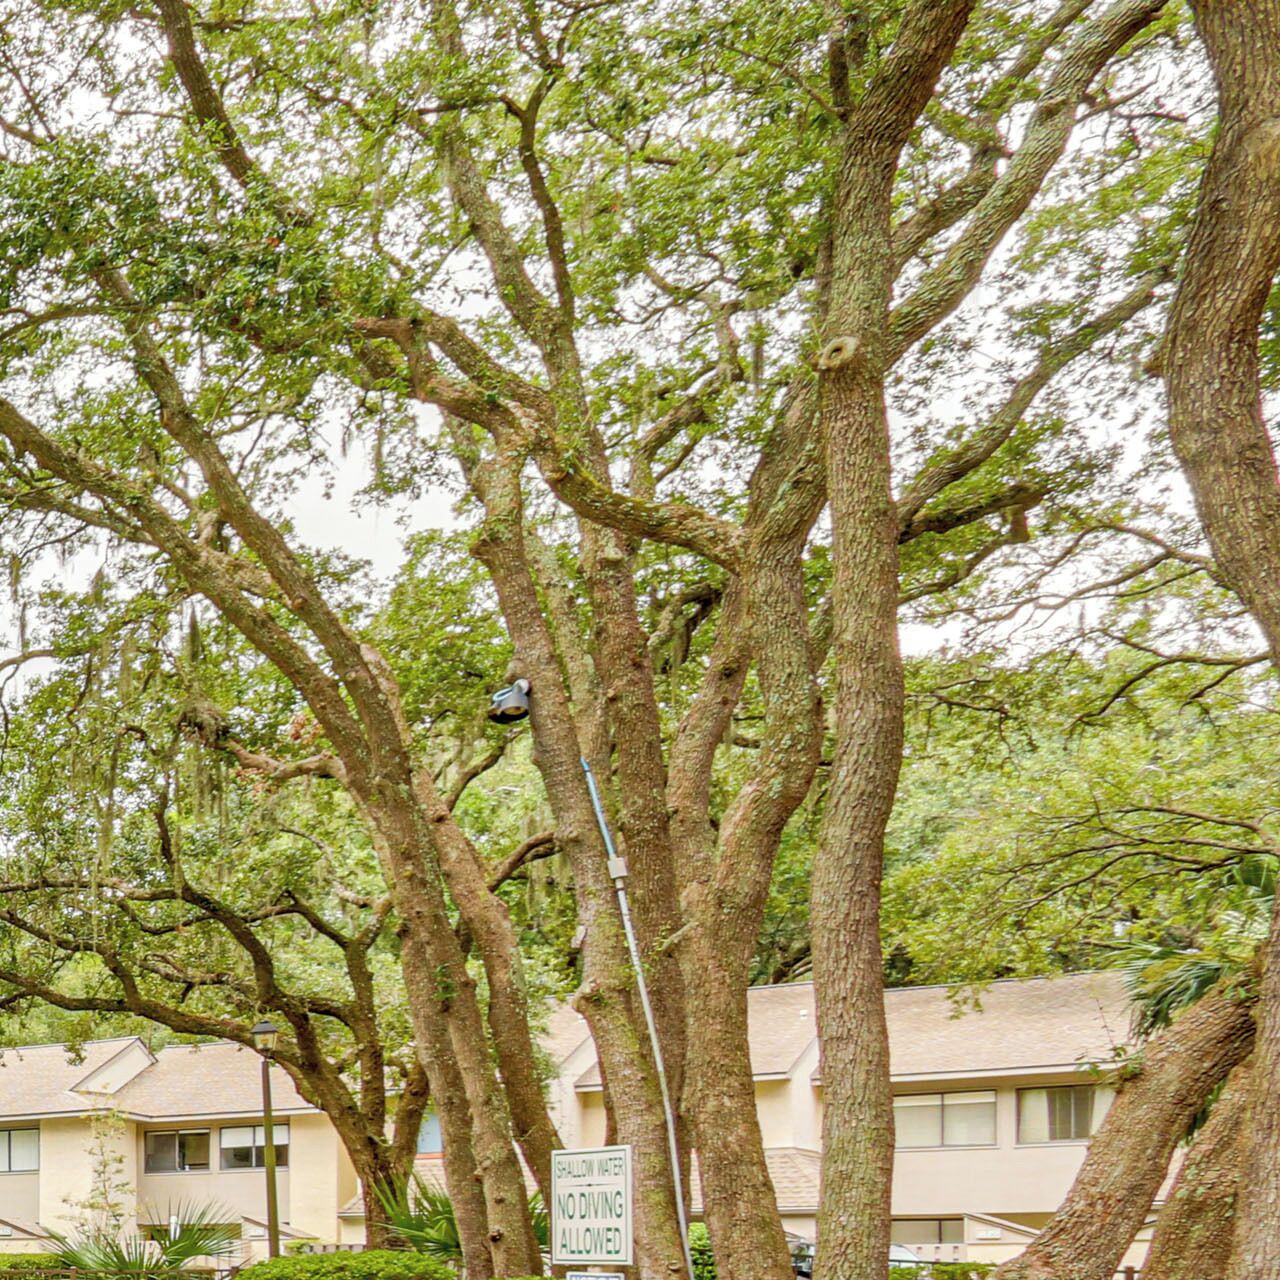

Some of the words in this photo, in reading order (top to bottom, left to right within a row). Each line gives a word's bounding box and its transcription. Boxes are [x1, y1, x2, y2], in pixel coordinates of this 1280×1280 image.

[557, 1159, 594, 1178] SHALLOW
[597, 1157, 624, 1176] WATER
[558, 1192, 575, 1220] NO
[579, 1190, 623, 1219] DIVING
[560, 1227, 622, 1255] ALLOWED
